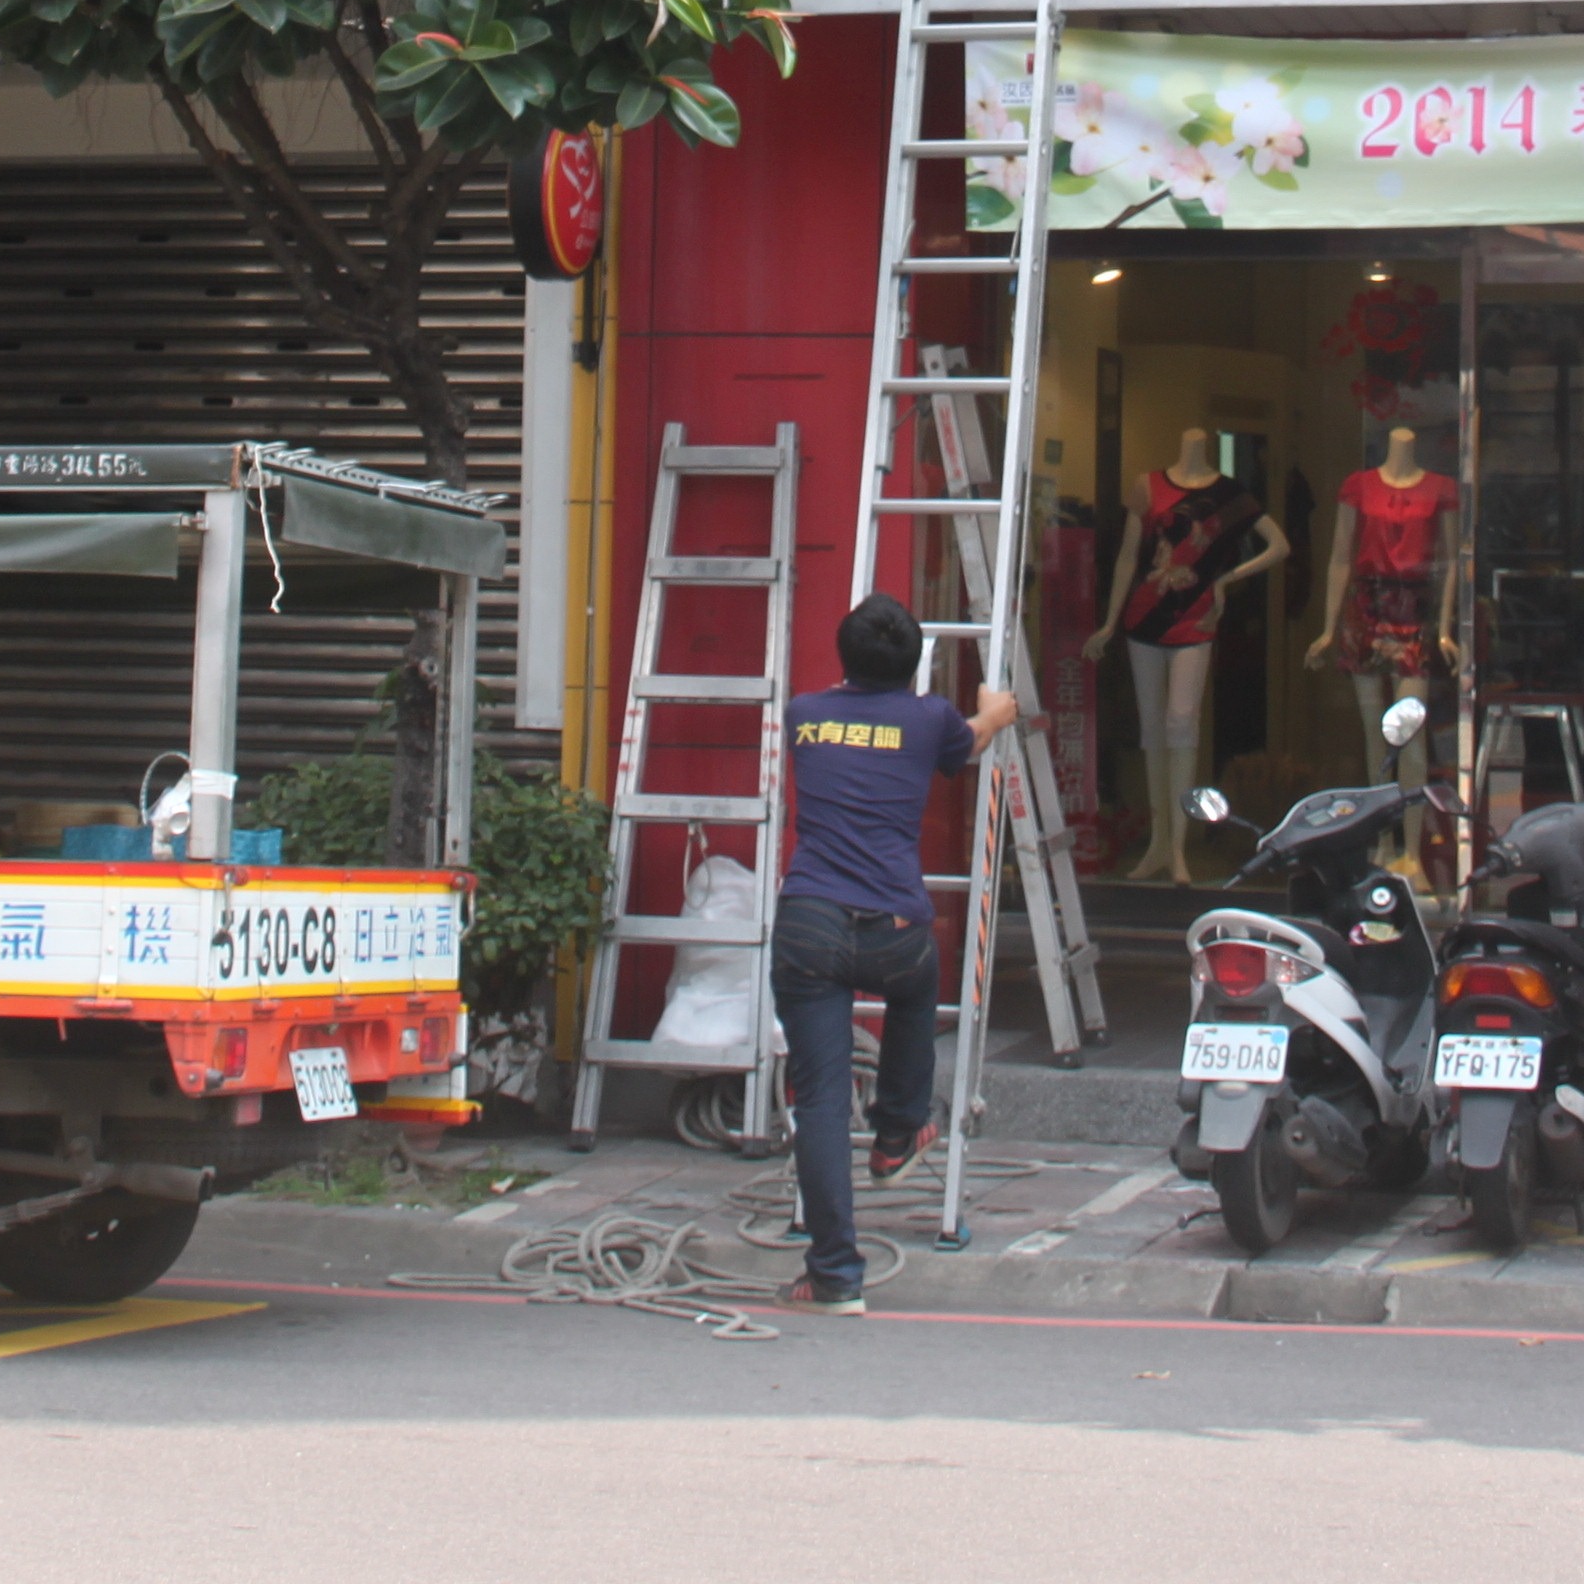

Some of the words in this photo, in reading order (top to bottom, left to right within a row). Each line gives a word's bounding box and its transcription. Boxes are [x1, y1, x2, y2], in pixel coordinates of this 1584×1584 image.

[795, 720, 903, 751] 大有空調
[216, 905, 337, 979] 5130-C8
[353, 904, 453, 964] 日立冷氣
